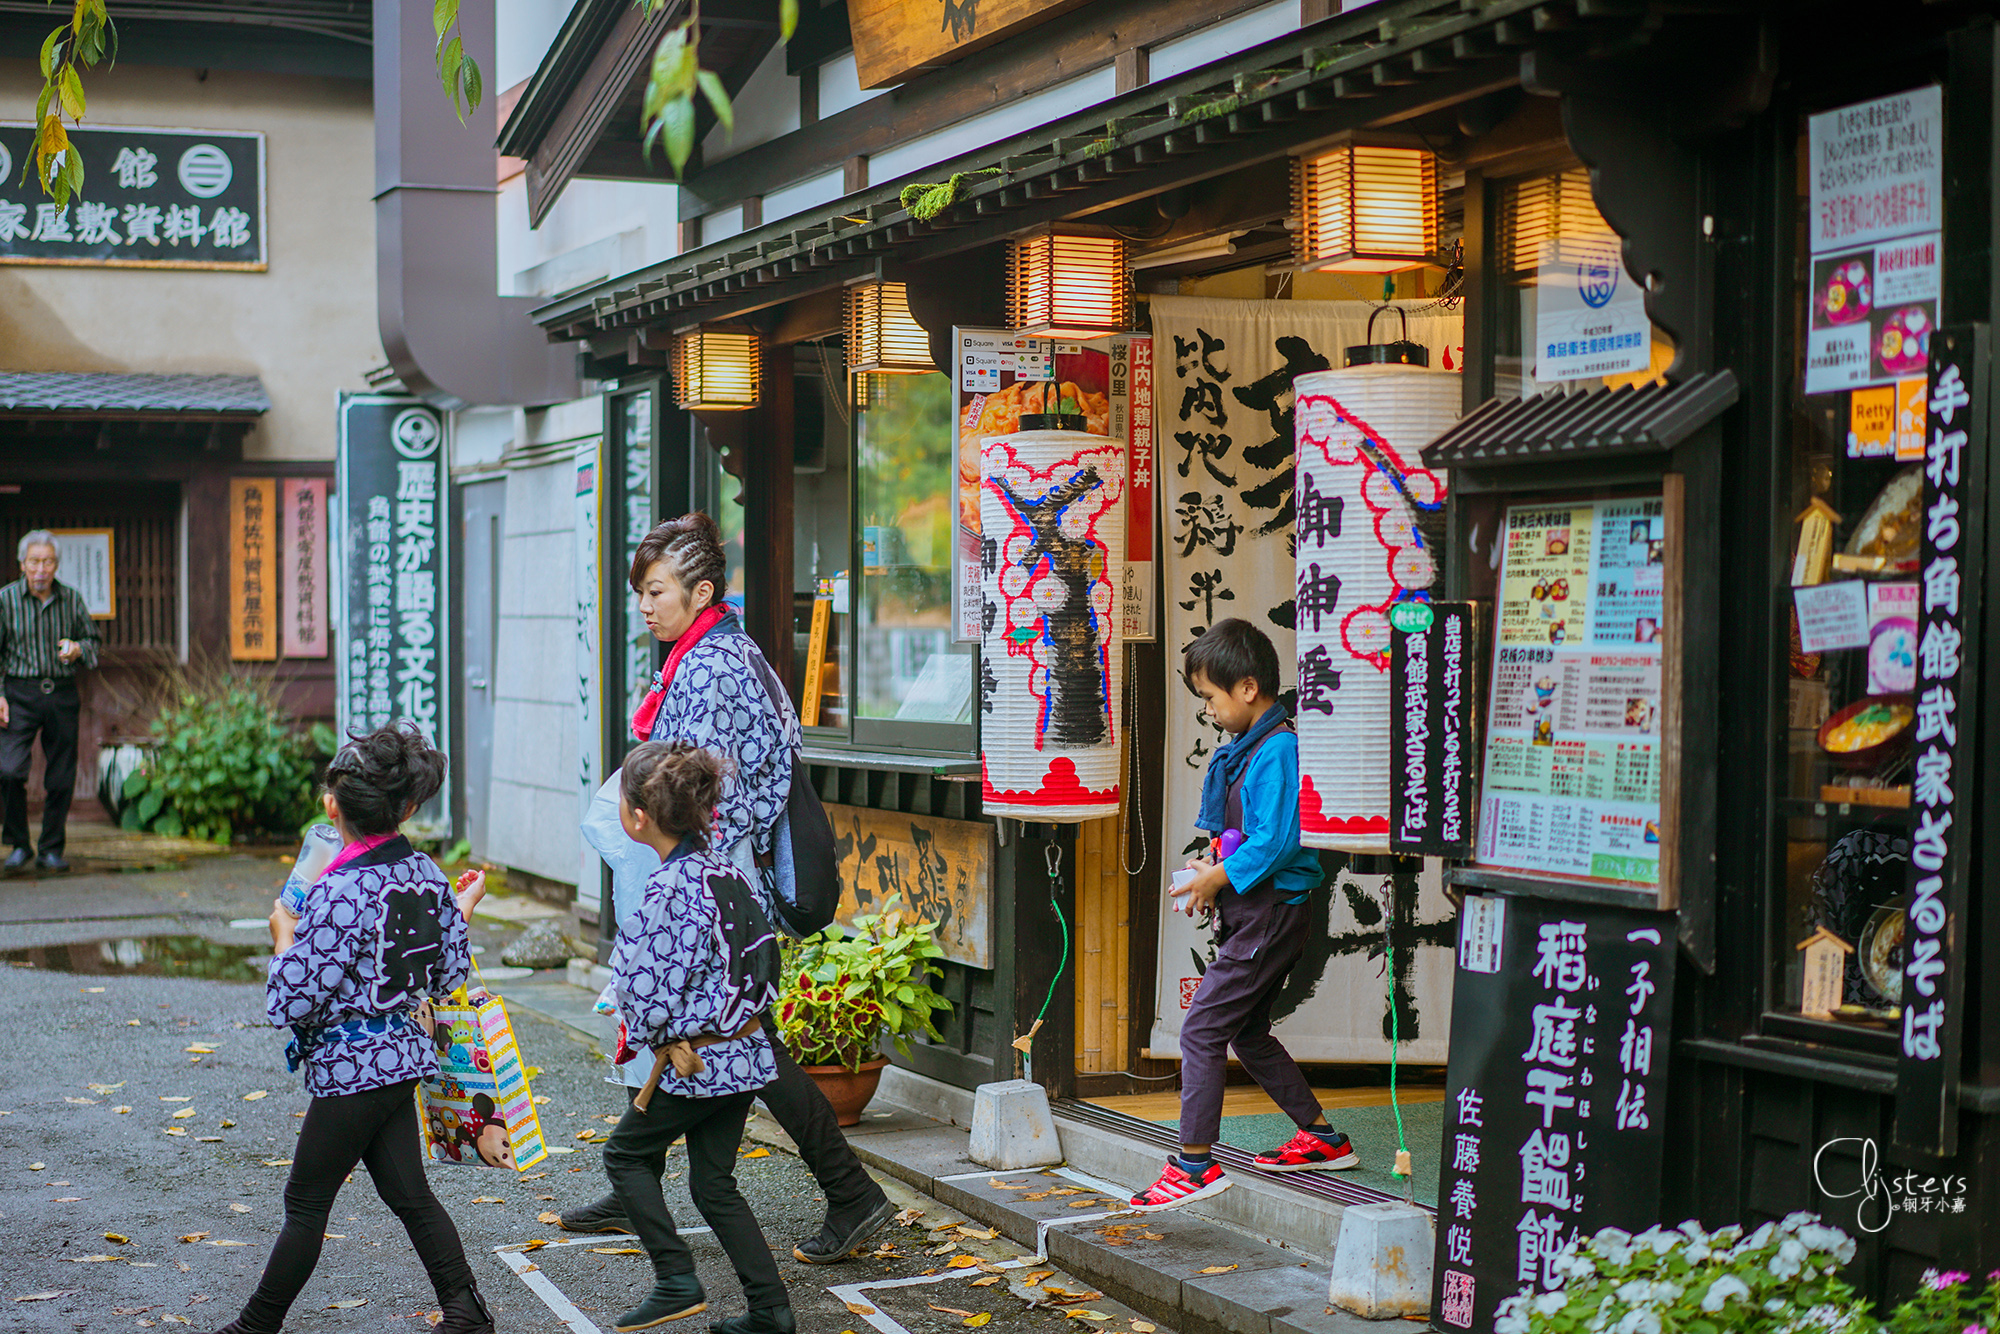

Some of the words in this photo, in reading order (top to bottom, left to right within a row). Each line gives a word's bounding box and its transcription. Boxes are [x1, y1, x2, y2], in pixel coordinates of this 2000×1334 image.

[976, 356, 997, 364] Square
[1111, 343, 1127, 397] 桜の里
[1133, 345, 1151, 489] 比内地鶏親子丼
[1856, 404, 1892, 420] Retty
[1442, 614, 1462, 842] 当店で打っている手打ちそば
[1902, 363, 1970, 1060] 手打ち角館武家ざるそば
[1515, 919, 1588, 1291] 稲庭干饂飩
[1616, 928, 1662, 1131] 一子相伝
[1447, 1087, 1484, 1268] 佐藤養悦
